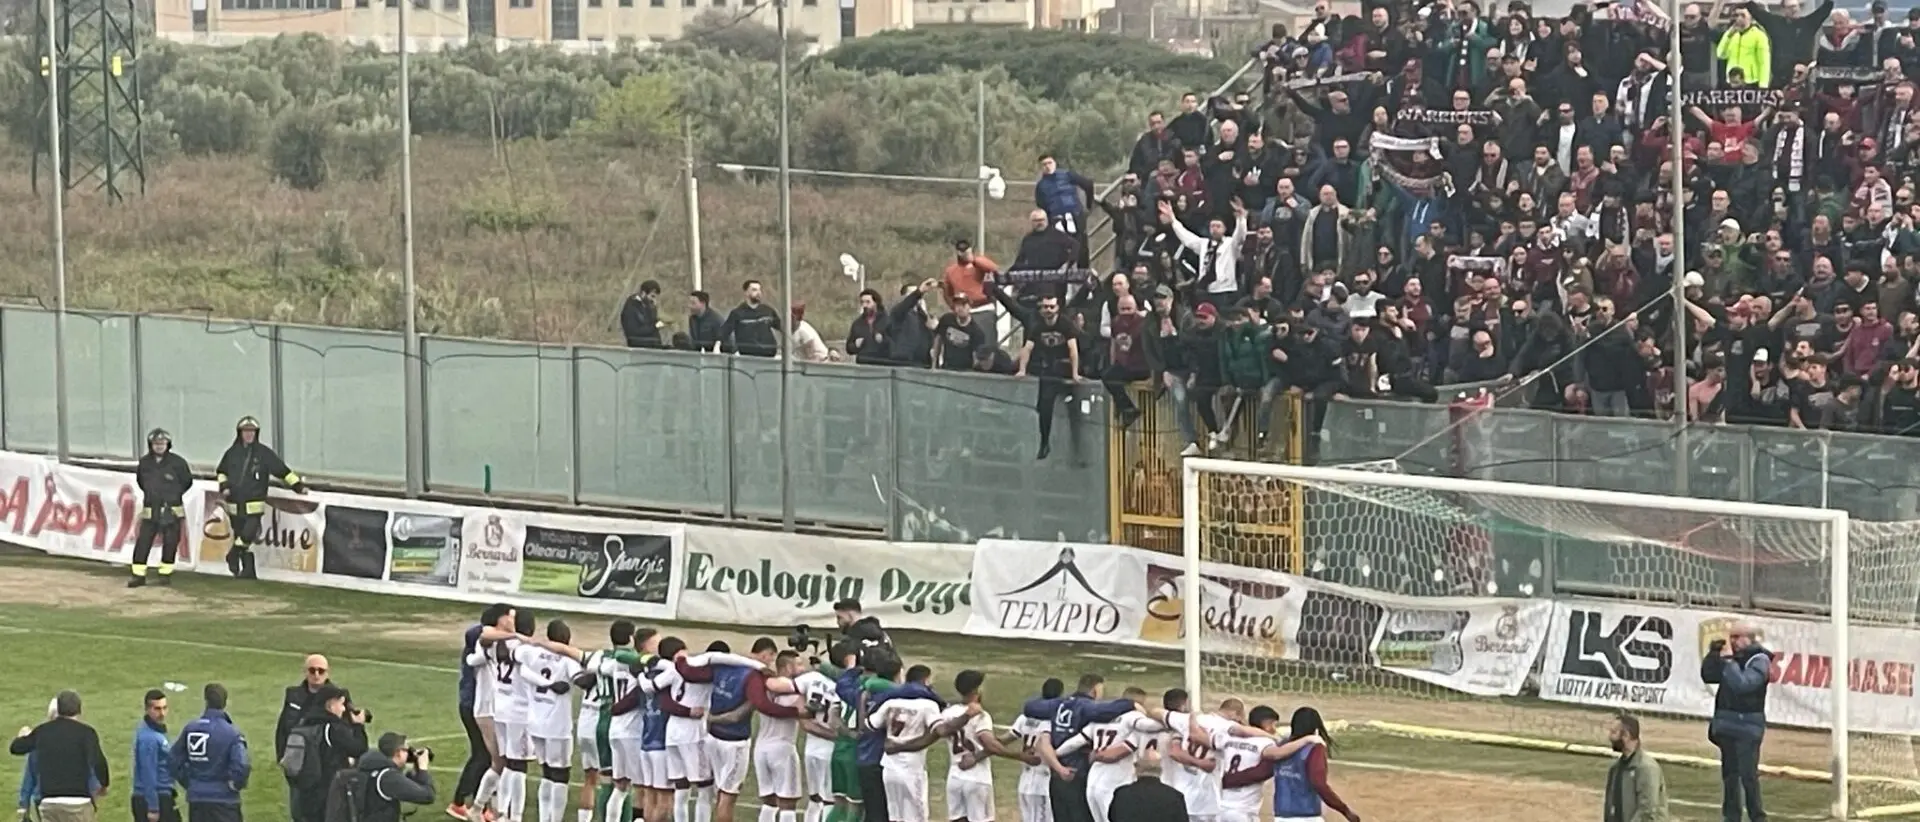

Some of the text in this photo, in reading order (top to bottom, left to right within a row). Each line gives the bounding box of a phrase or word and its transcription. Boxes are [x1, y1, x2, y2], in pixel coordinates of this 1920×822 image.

[1680, 89, 1779, 106] WARRIORS
[1397, 108, 1491, 124] WARRIORS
[685, 552, 864, 608] Ecologia
[999, 599, 1121, 635] TEMPIO
[1560, 610, 1673, 684] LKS
[1594, 682, 1630, 702] KAPPA
[1631, 685, 1667, 705] SPORT
[1096, 728, 1118, 752] 17
